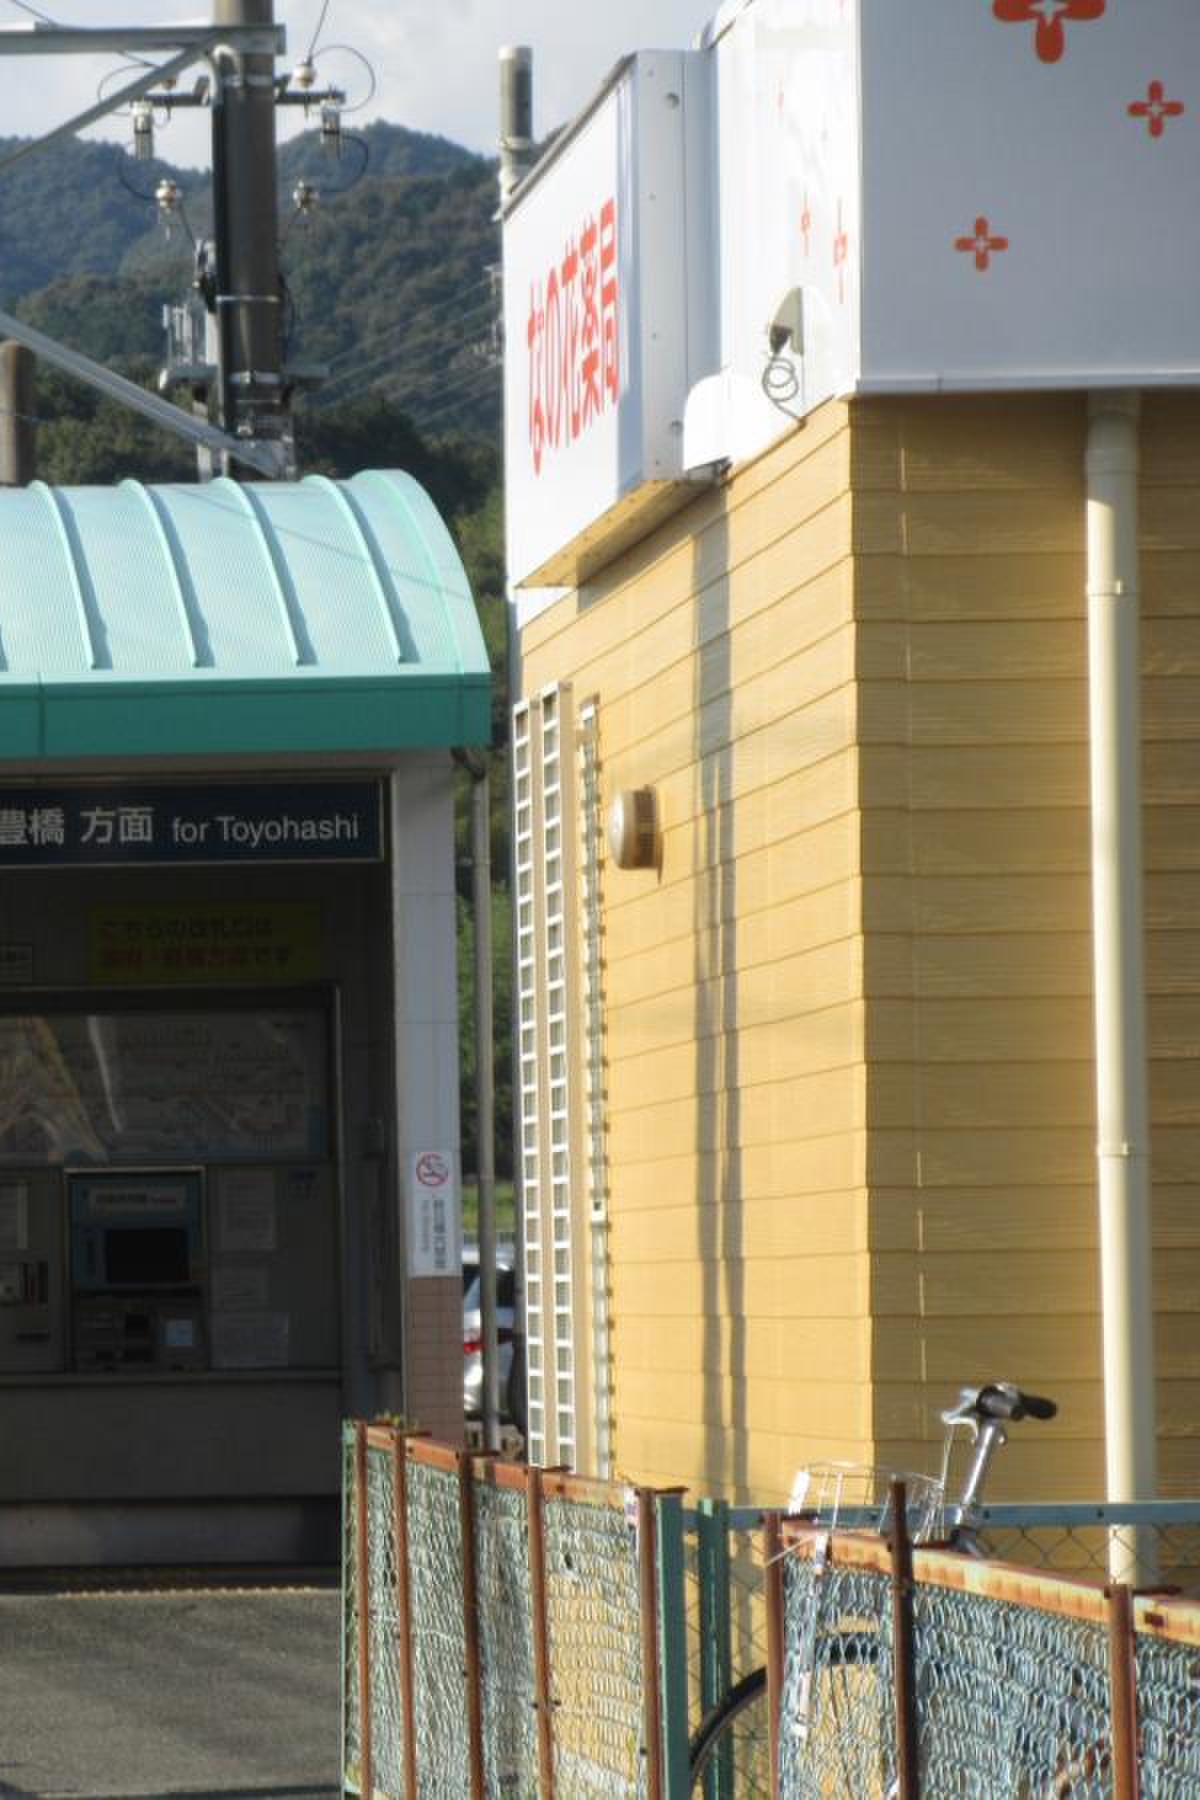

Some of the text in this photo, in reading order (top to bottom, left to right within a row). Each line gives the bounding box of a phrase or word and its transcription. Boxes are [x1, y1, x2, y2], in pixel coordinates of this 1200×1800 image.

[528, 197, 619, 477] なの花薬局
[79, 806, 155, 844] 方面
[172, 813, 360, 849] for Toyohashi
